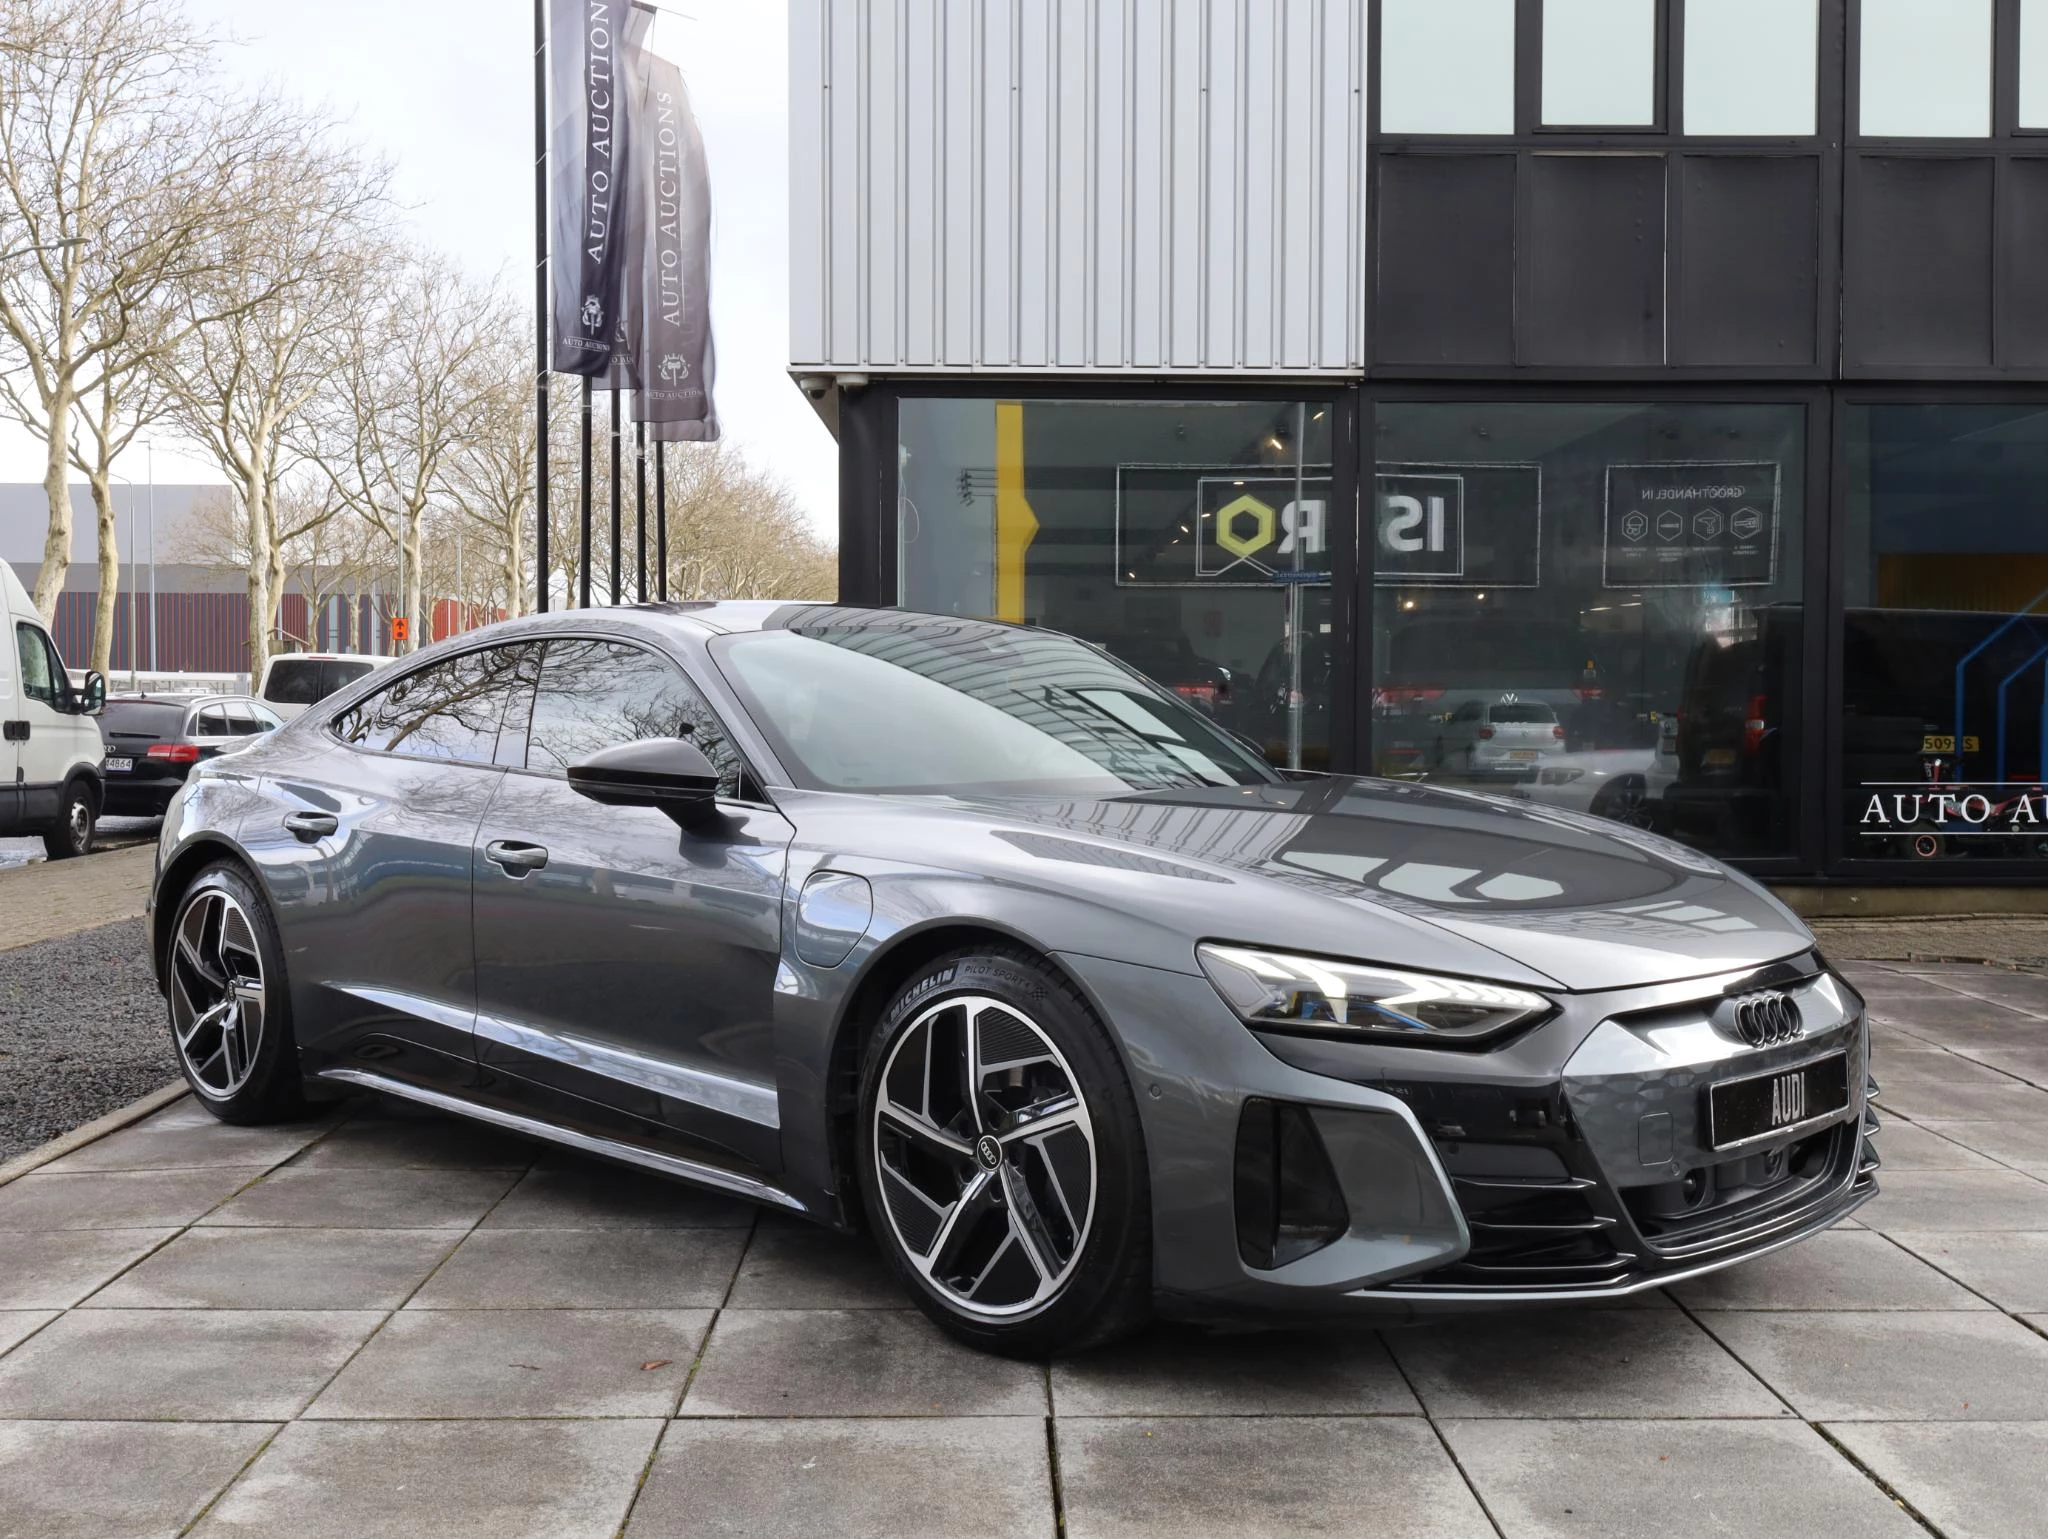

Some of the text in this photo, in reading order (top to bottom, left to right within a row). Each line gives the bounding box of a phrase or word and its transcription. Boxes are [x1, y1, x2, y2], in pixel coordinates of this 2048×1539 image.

[586, 170, 608, 264] AUTO
[656, 91, 680, 328] AUTO AUCTIONS
[1860, 793, 1991, 823] AUTO
[889, 967, 954, 1020] MICHELIN
[993, 968, 1025, 985] SPORT
[1771, 1071, 1806, 1126] AUDI
